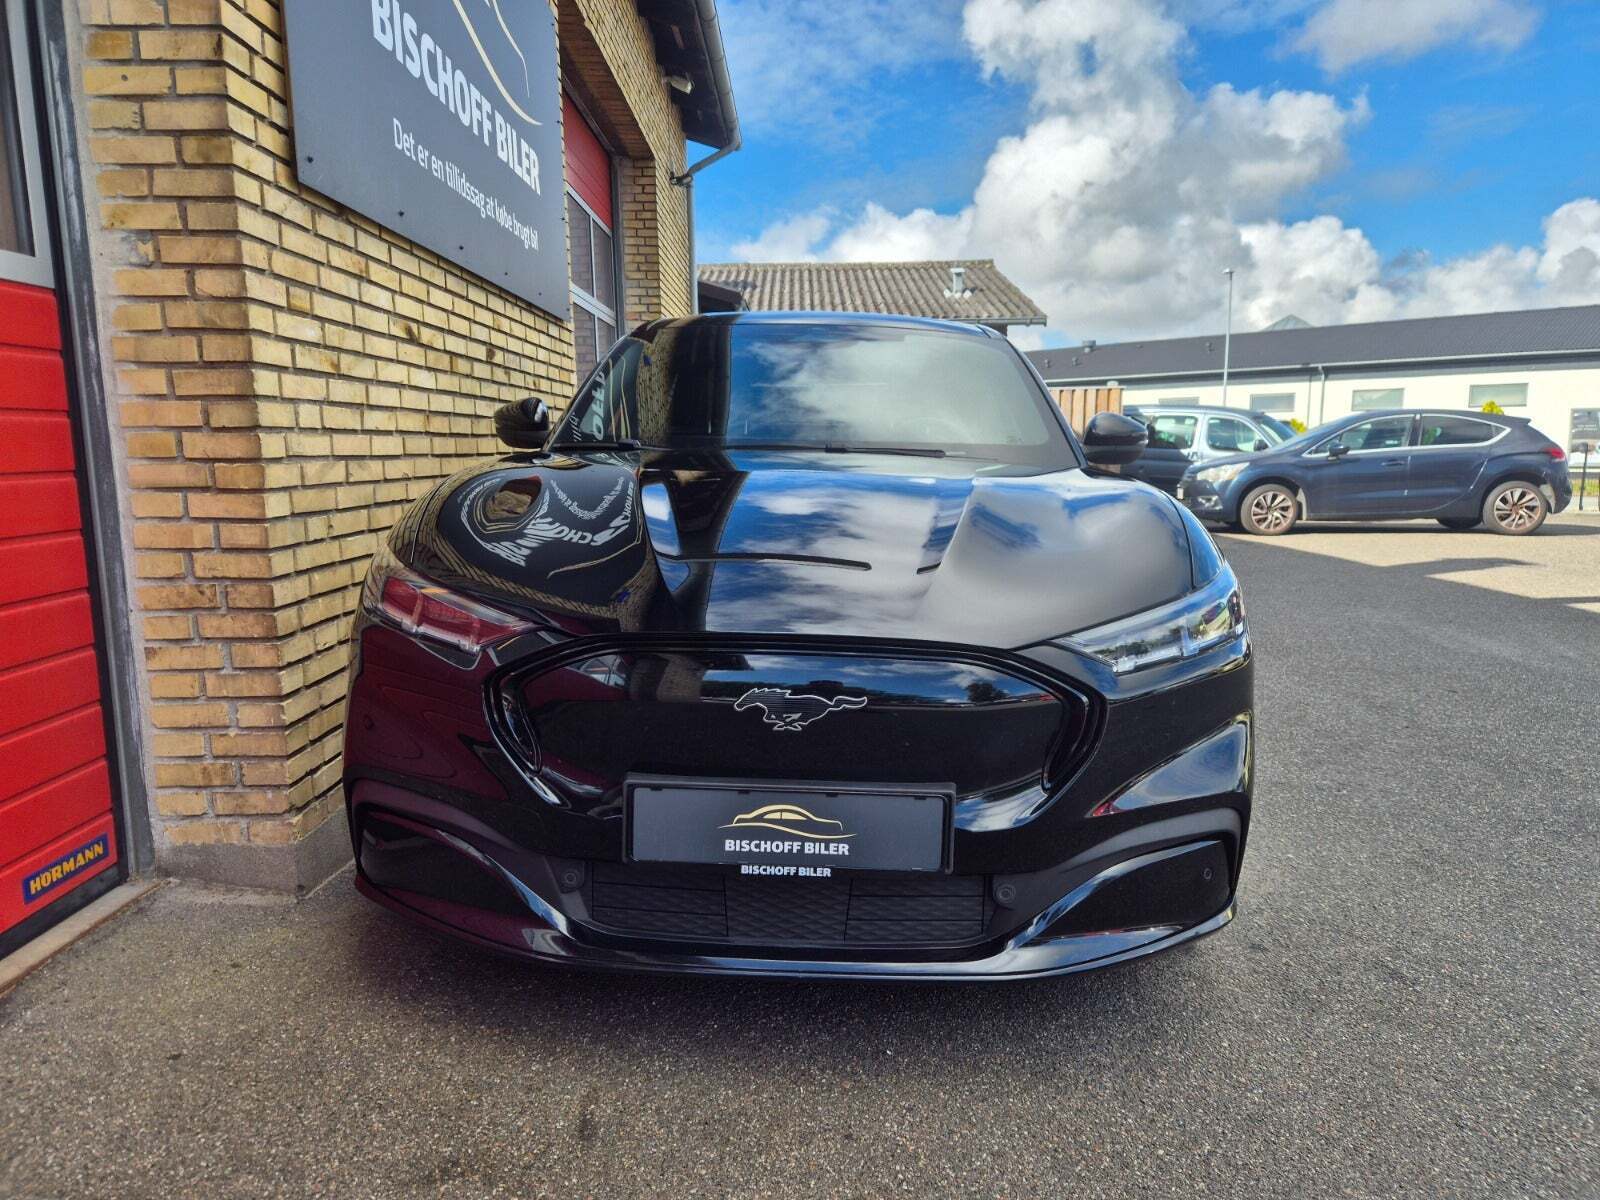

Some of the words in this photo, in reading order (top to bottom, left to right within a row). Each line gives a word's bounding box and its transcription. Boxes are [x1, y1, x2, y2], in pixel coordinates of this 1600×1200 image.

[371, 0, 492, 147] BISCHOFF
[495, 109, 541, 195] BILER
[393, 117, 416, 161] Det
[418, 144, 429, 170] er
[431, 154, 445, 182] en
[445, 160, 486, 219] tillidssag
[486, 196, 495, 219] at
[495, 198, 513, 232] købe
[513, 212, 531, 249] brugt
[530, 226, 539, 250] bil
[724, 839, 802, 854] BISCHOFF
[804, 842, 850, 856] BILER
[740, 864, 797, 876] BISCHOFF
[798, 867, 832, 878] BILER
